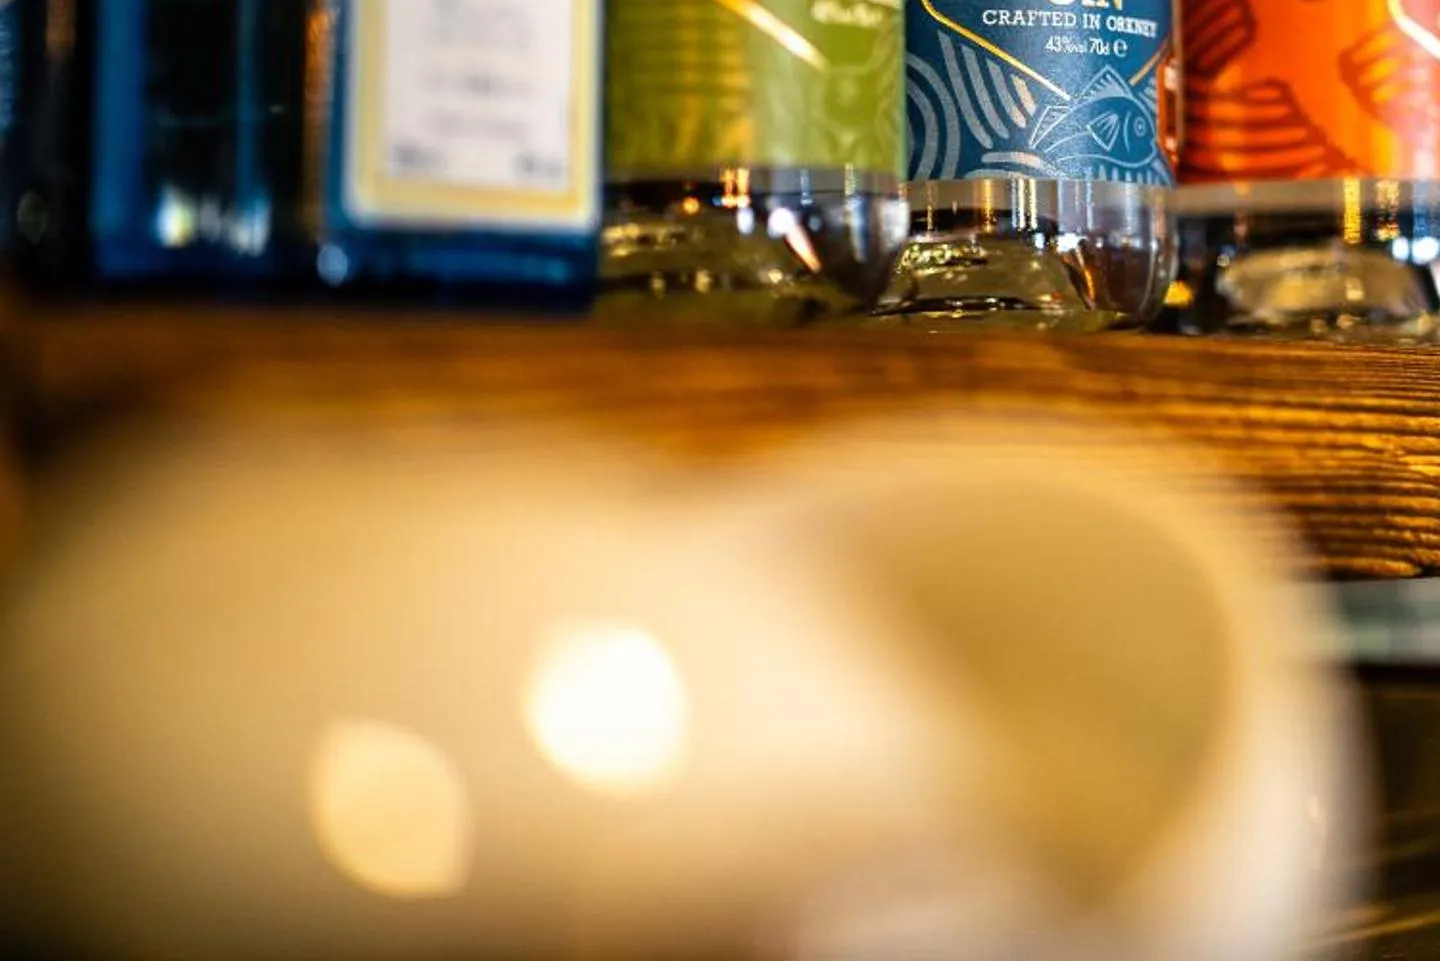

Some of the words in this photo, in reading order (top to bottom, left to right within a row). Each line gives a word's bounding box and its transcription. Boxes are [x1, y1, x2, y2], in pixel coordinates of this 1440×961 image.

[982, 10, 1077, 26] CRAFTED
[1082, 13, 1101, 30] IN
[1106, 15, 1158, 38] ORKNEY
